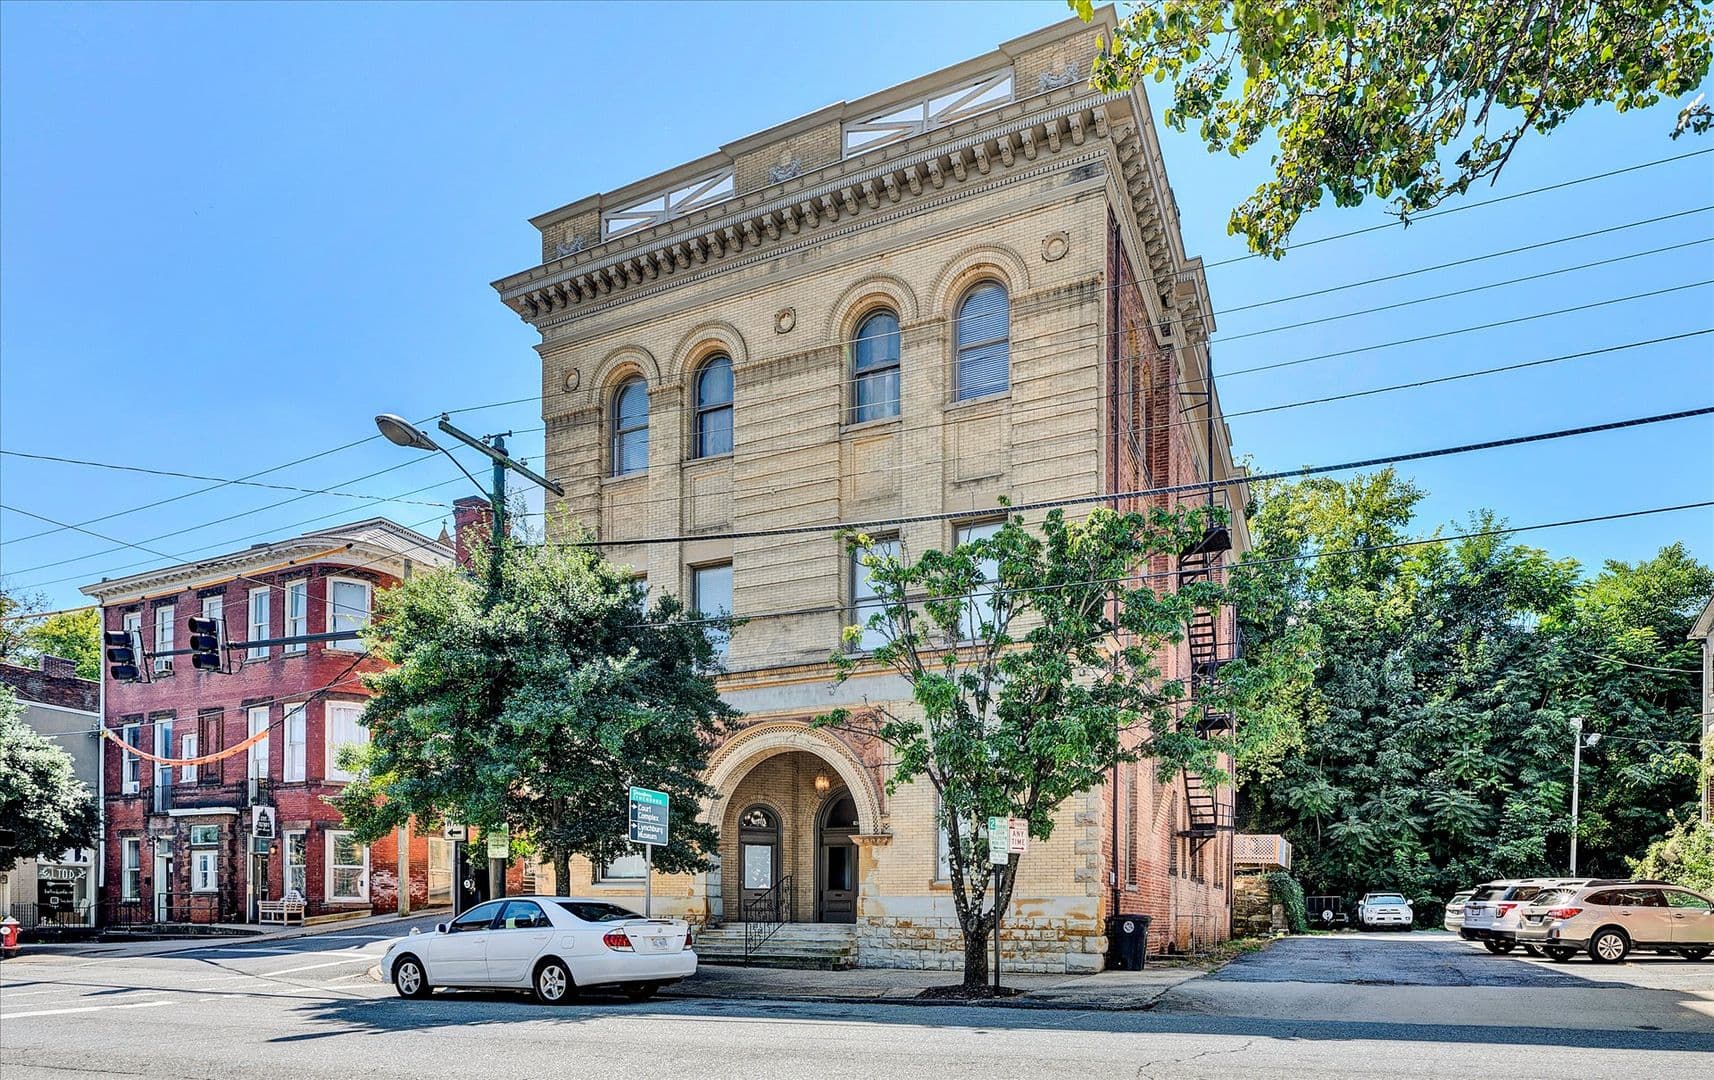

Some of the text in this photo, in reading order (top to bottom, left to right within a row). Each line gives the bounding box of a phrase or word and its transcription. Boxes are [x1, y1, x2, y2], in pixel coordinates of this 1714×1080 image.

[638, 804, 652, 812] Court
[638, 813, 659, 822] Complex
[989, 818, 996, 830] 2
[638, 823, 663, 835] Lynchburg
[1012, 830, 1025, 838] ANY
[1011, 838, 1026, 846] TIME
